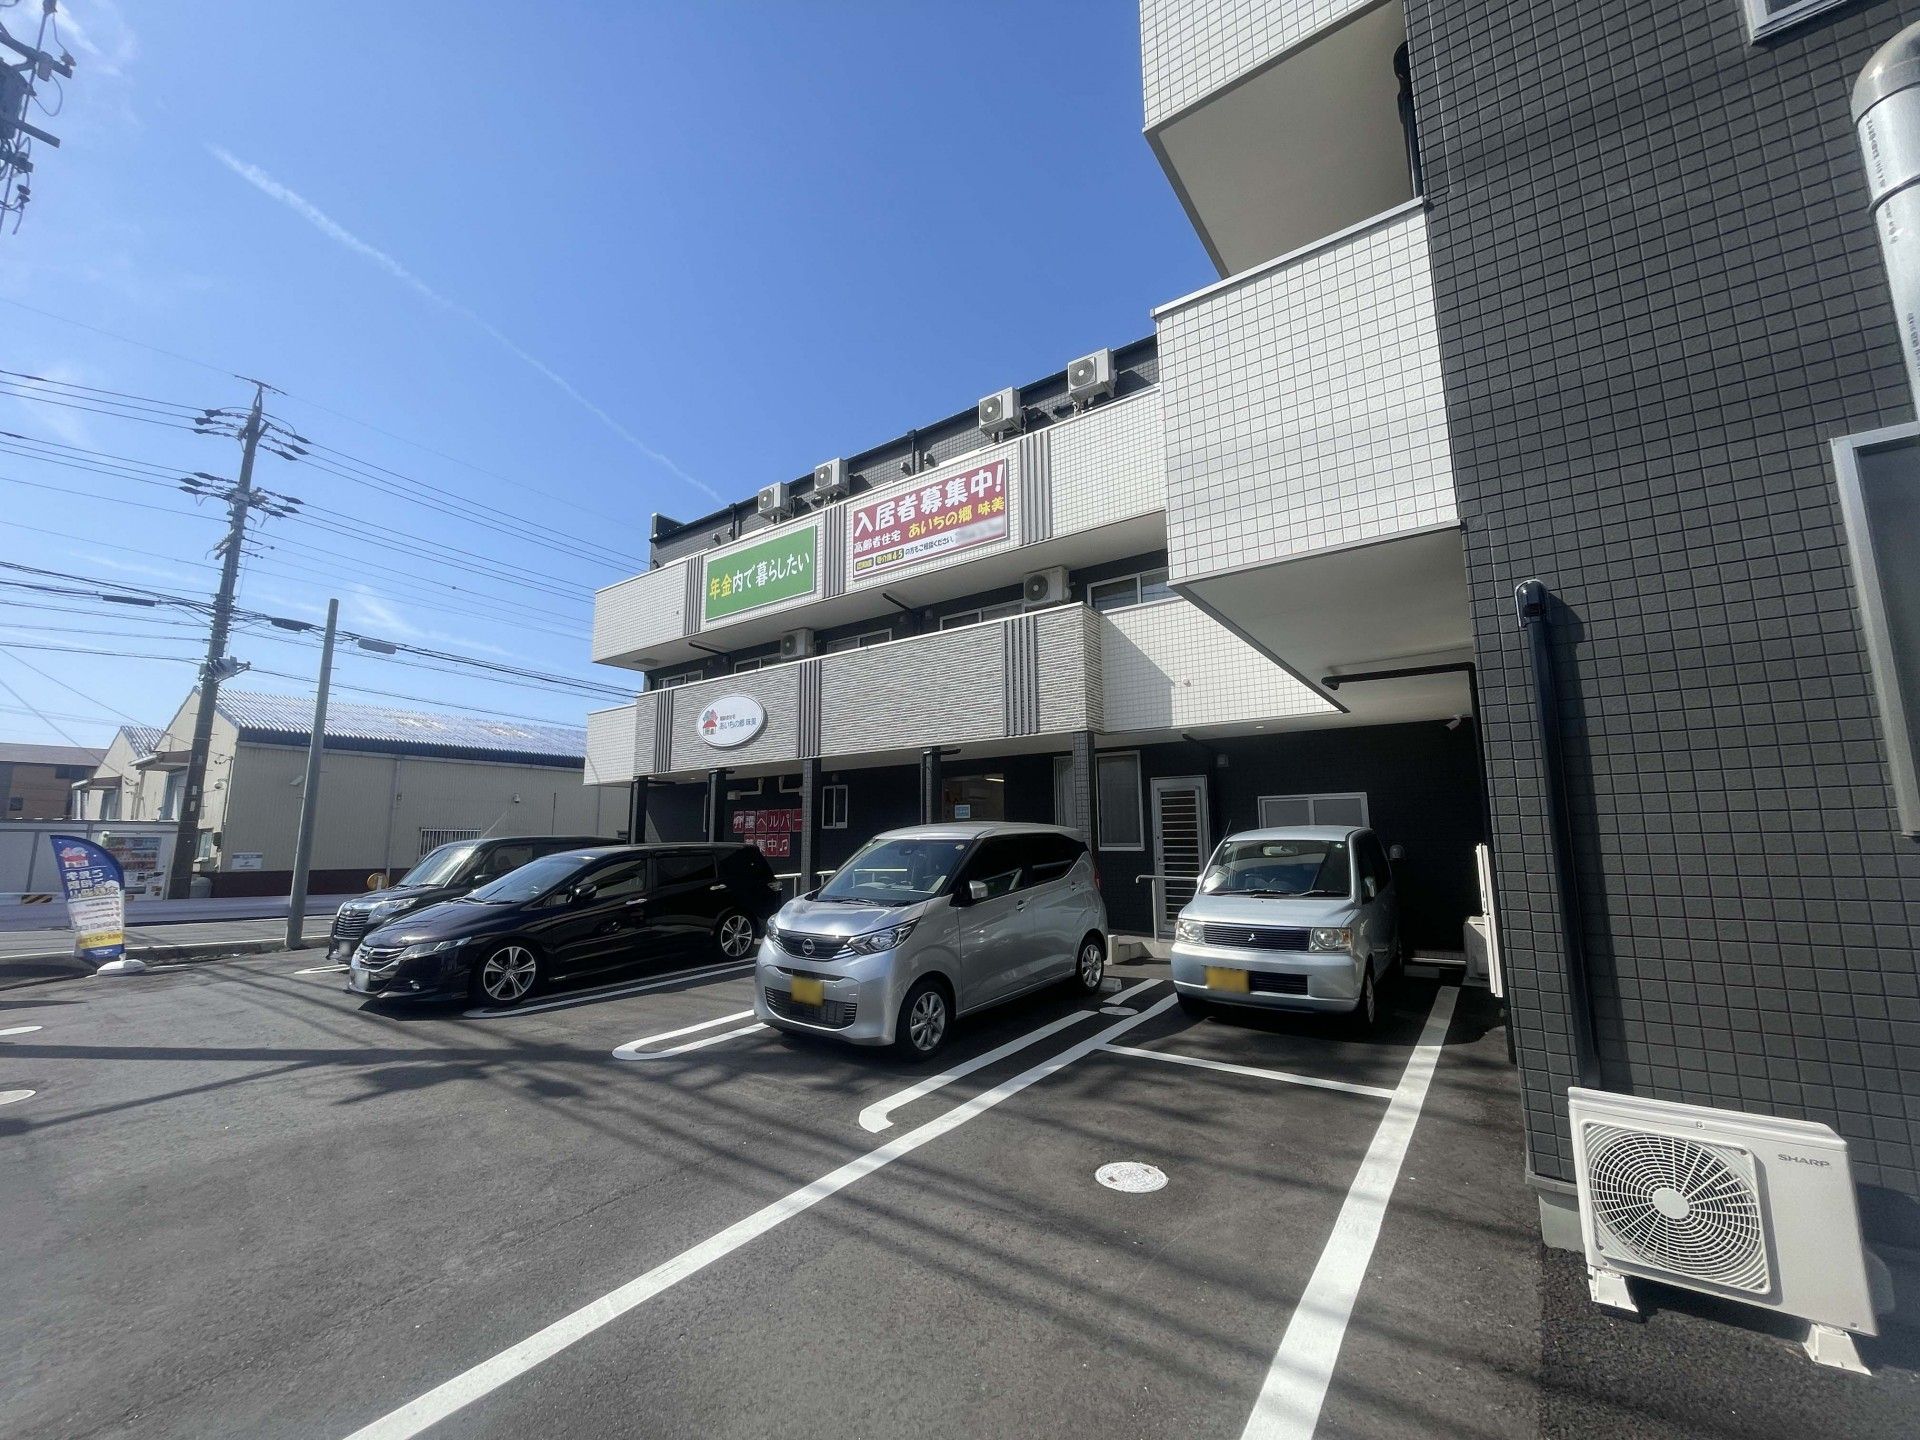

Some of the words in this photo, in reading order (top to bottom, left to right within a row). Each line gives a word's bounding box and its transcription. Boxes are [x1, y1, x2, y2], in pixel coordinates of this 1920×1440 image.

[854, 529, 901, 552] 高齢者住宅
[908, 504, 972, 538] あいちの郷
[977, 496, 1004, 516] 味美
[709, 552, 810, 600] 年金内で暮らしたい
[1777, 1153, 1831, 1167] SHARP
